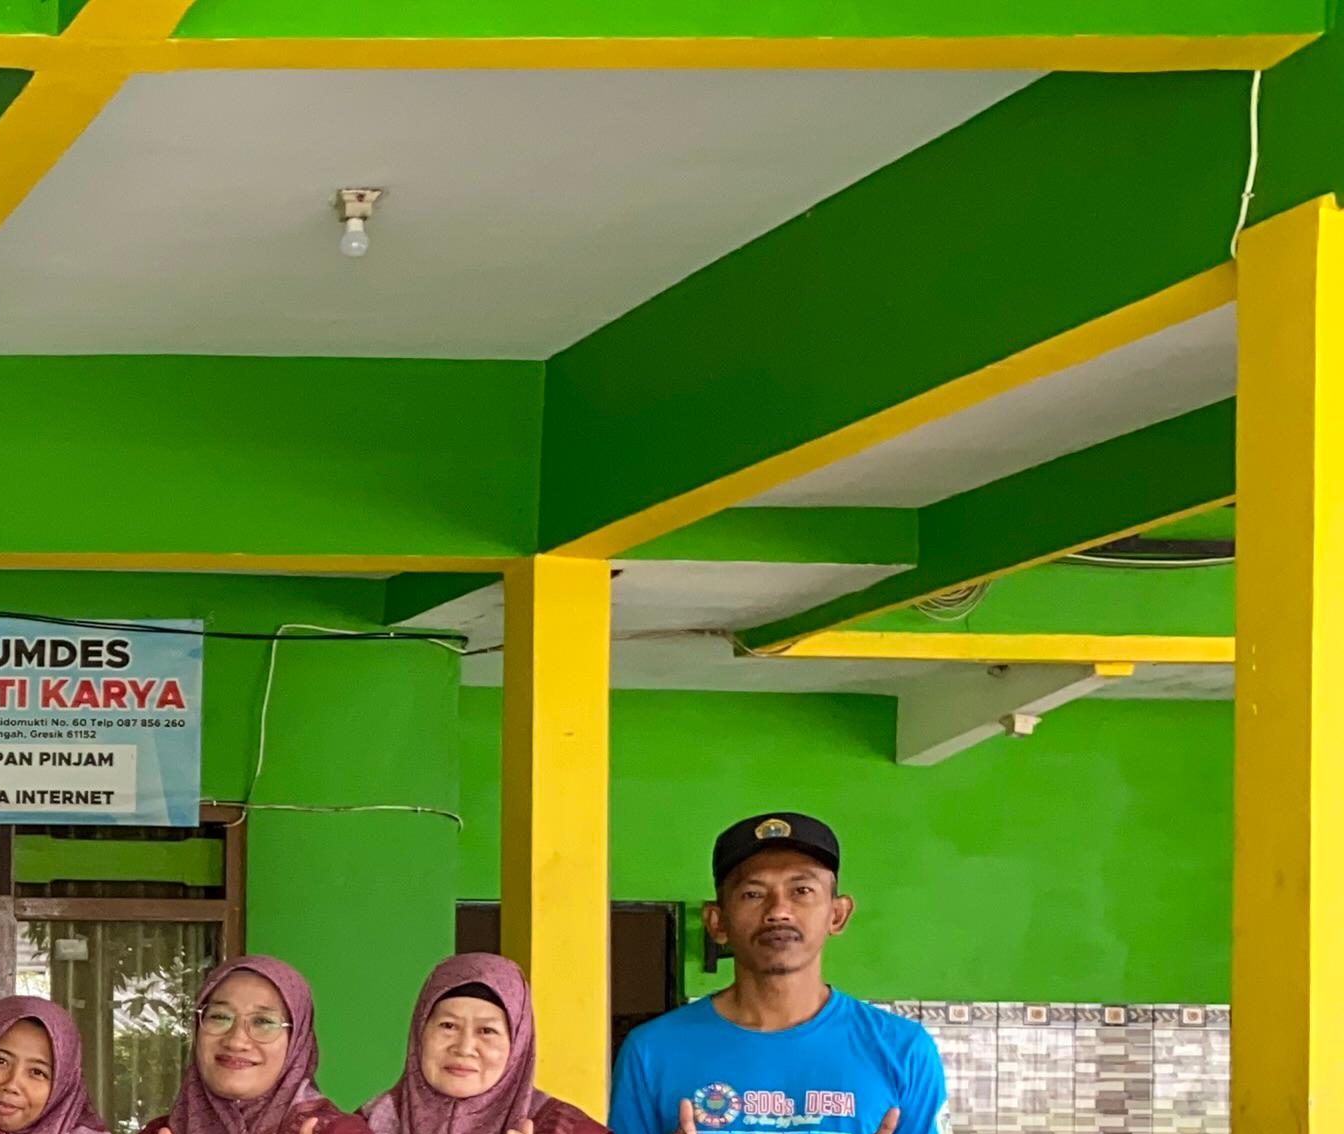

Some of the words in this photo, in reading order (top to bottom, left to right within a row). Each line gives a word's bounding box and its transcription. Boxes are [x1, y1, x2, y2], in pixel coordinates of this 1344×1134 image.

[40, 678, 186, 709] KARYA
[51, 718, 69, 728] No.
[91, 718, 114, 729] Telp
[30, 729, 63, 739] Gresik
[39, 752, 114, 767] PINJAM
[16, 790, 115, 805] INTERNET
[744, 1091, 794, 1116] SDGs
[805, 1091, 855, 1117] DESA
